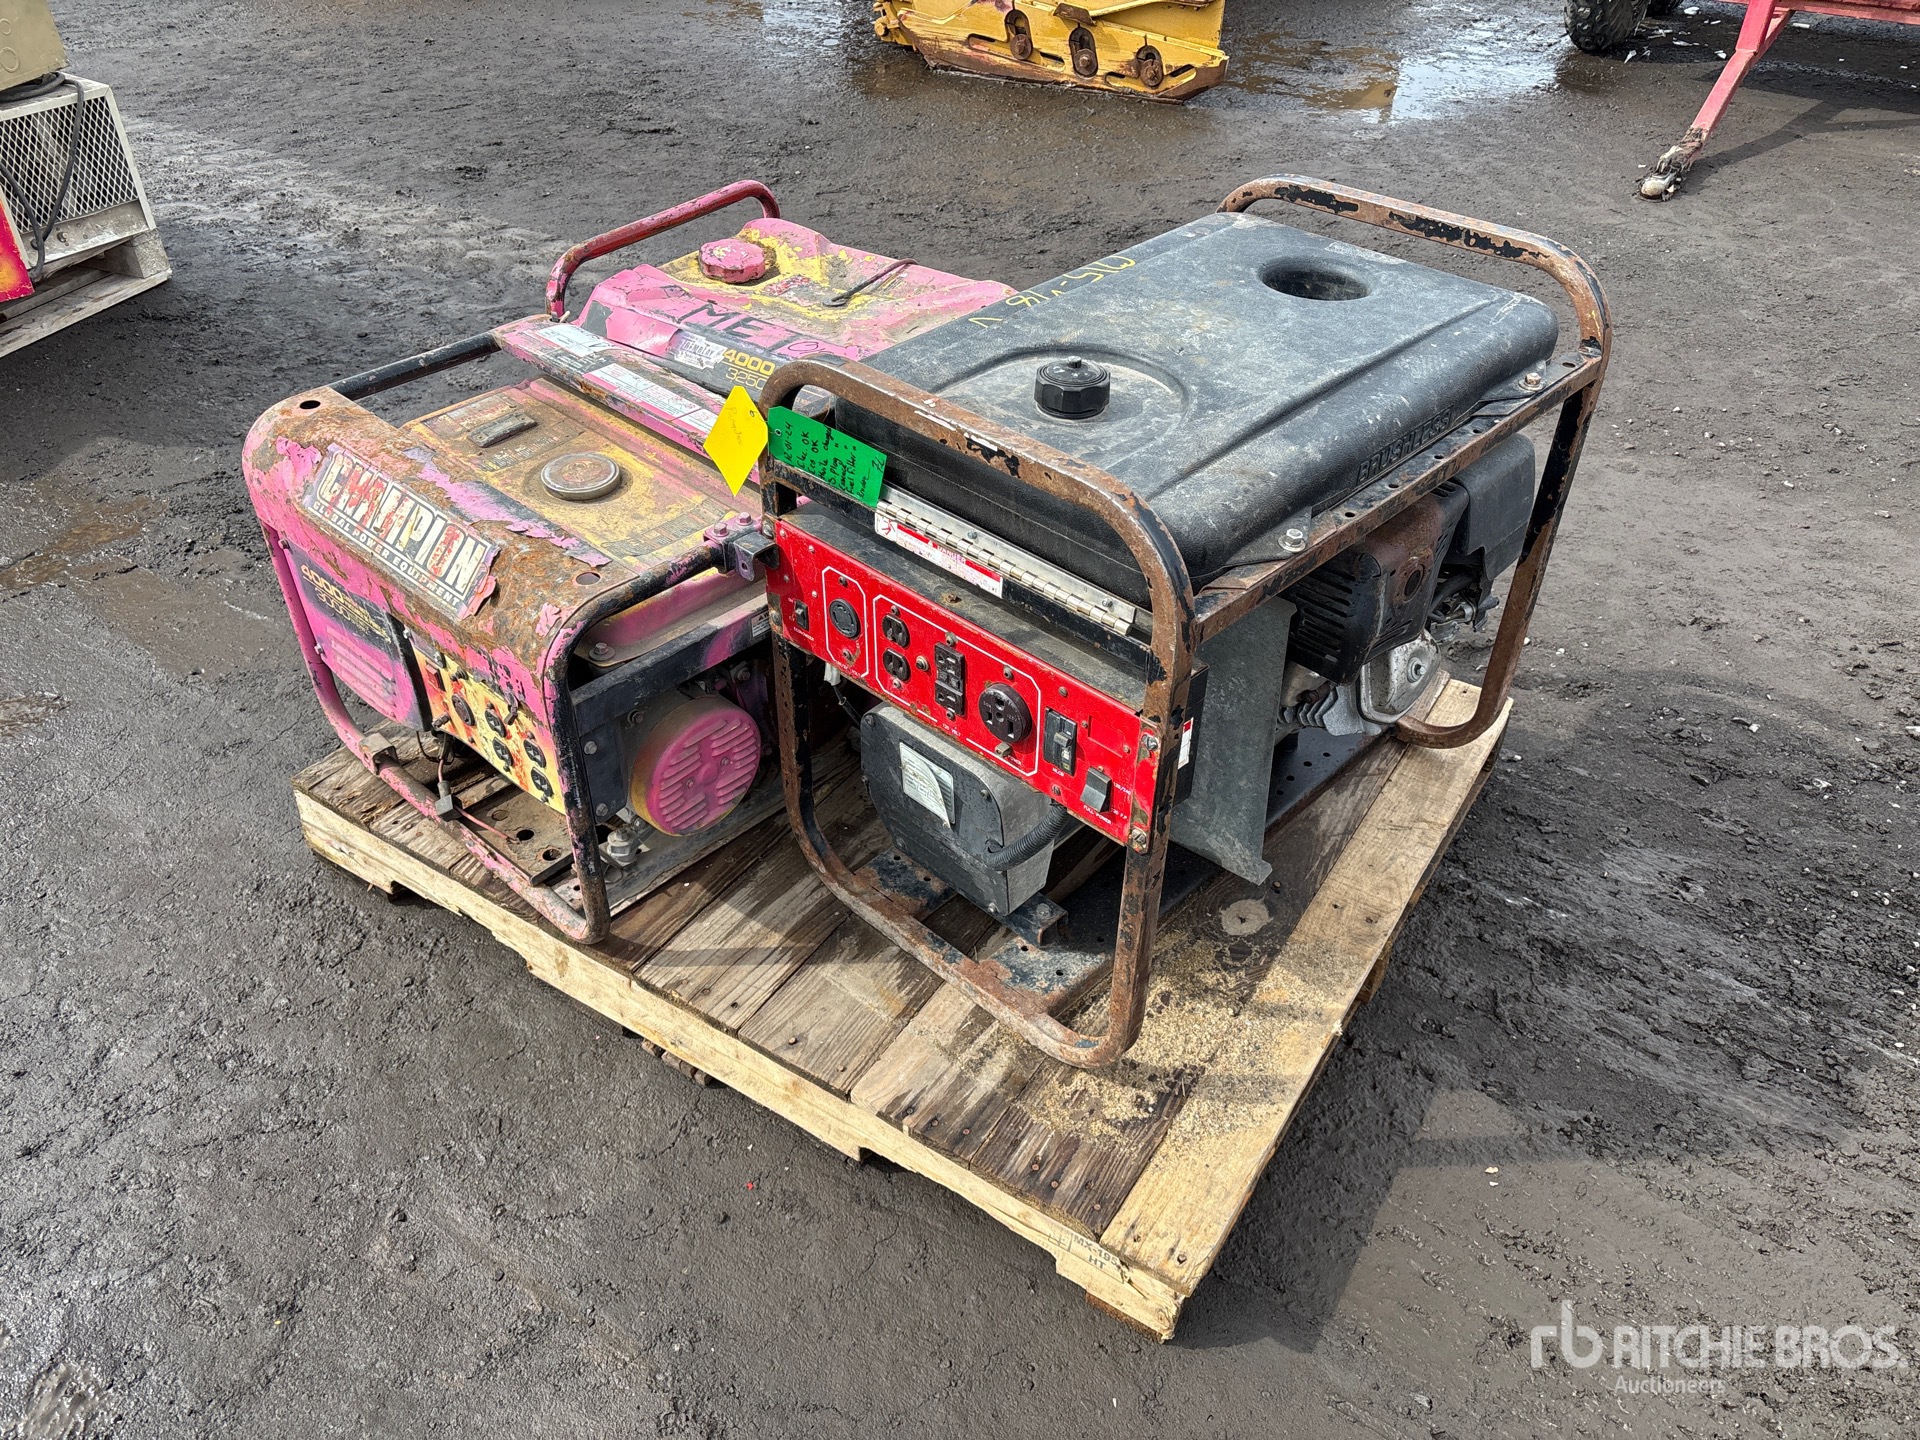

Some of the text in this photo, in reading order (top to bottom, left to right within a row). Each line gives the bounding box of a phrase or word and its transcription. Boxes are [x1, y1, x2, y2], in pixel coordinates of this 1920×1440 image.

[723, 349, 776, 376] 4000
[801, 431, 811, 446] OK
[811, 439, 820, 454] OK
[1356, 406, 1454, 486] BRUSHLESS
[318, 452, 490, 597] CHAMPION
[313, 501, 460, 607] GLOBAL POWER EQUIPMENT
[301, 564, 344, 603] 4000
[1083, 804, 1112, 825] FULL POWER
[1088, 1254, 1106, 1270] HT
